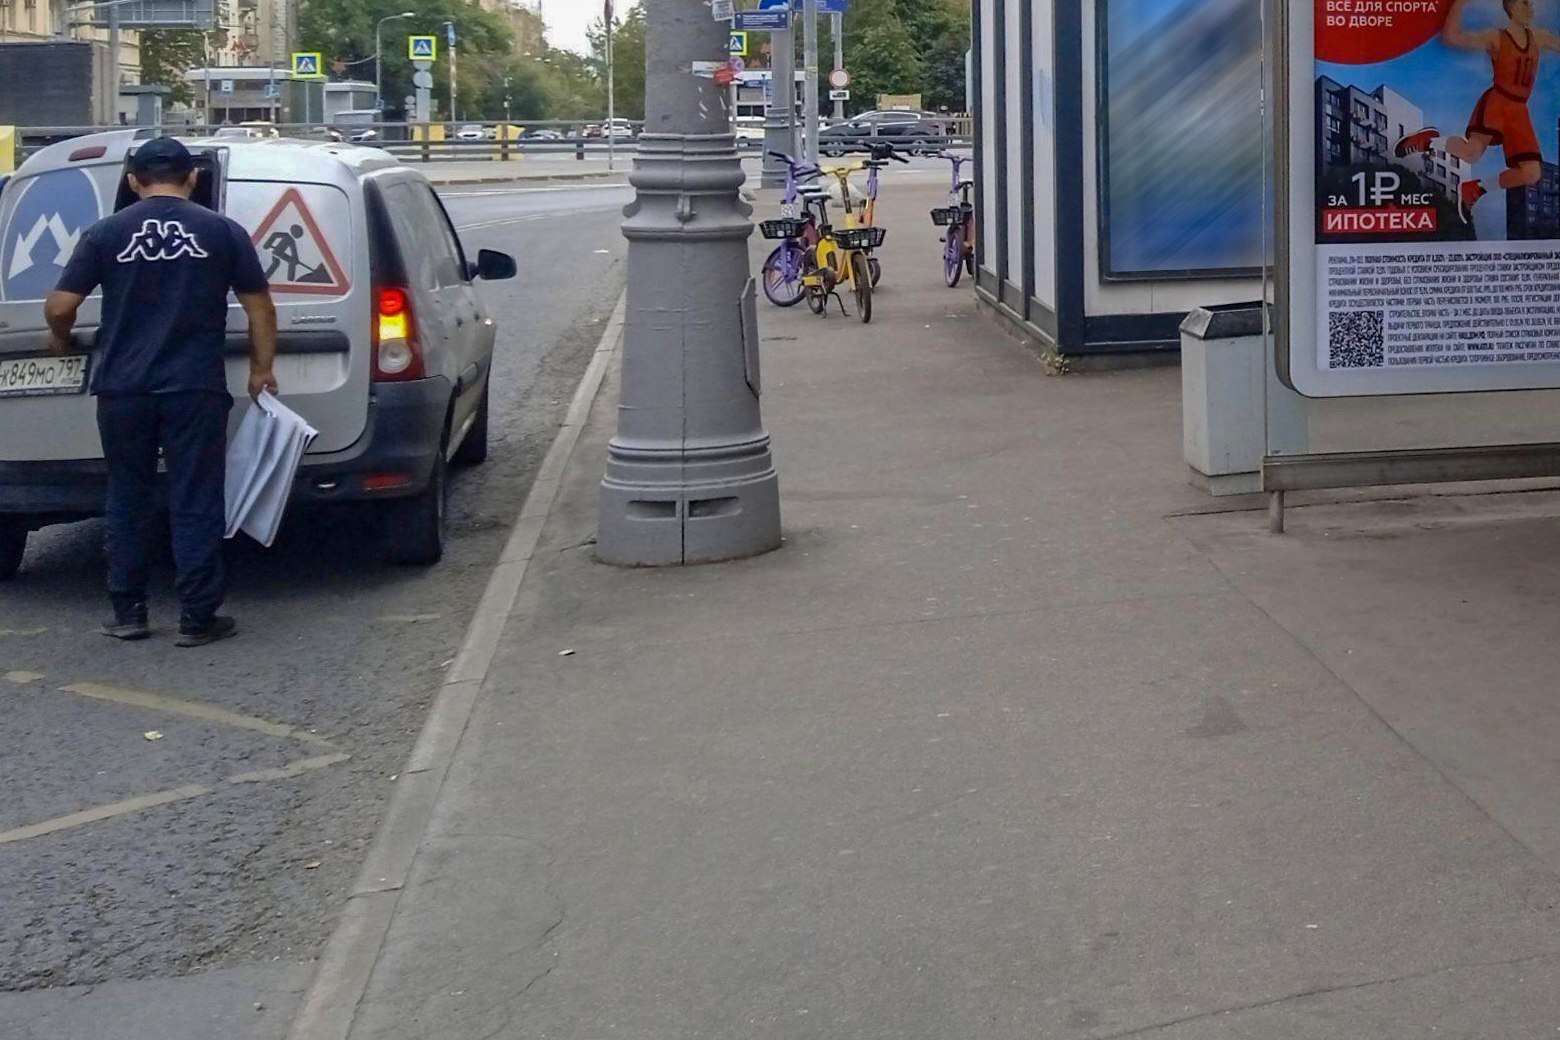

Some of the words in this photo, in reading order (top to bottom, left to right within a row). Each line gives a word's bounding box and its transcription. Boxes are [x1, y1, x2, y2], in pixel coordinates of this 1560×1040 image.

[1355, 1, 1383, 13] ДЛЯ
[1326, 16, 1346, 27] ВО
[1349, 16, 1393, 28] ДВОРЕ
[1327, 195, 1348, 206] ЗА
[1327, 212, 1434, 230] ИПОТЕКА
